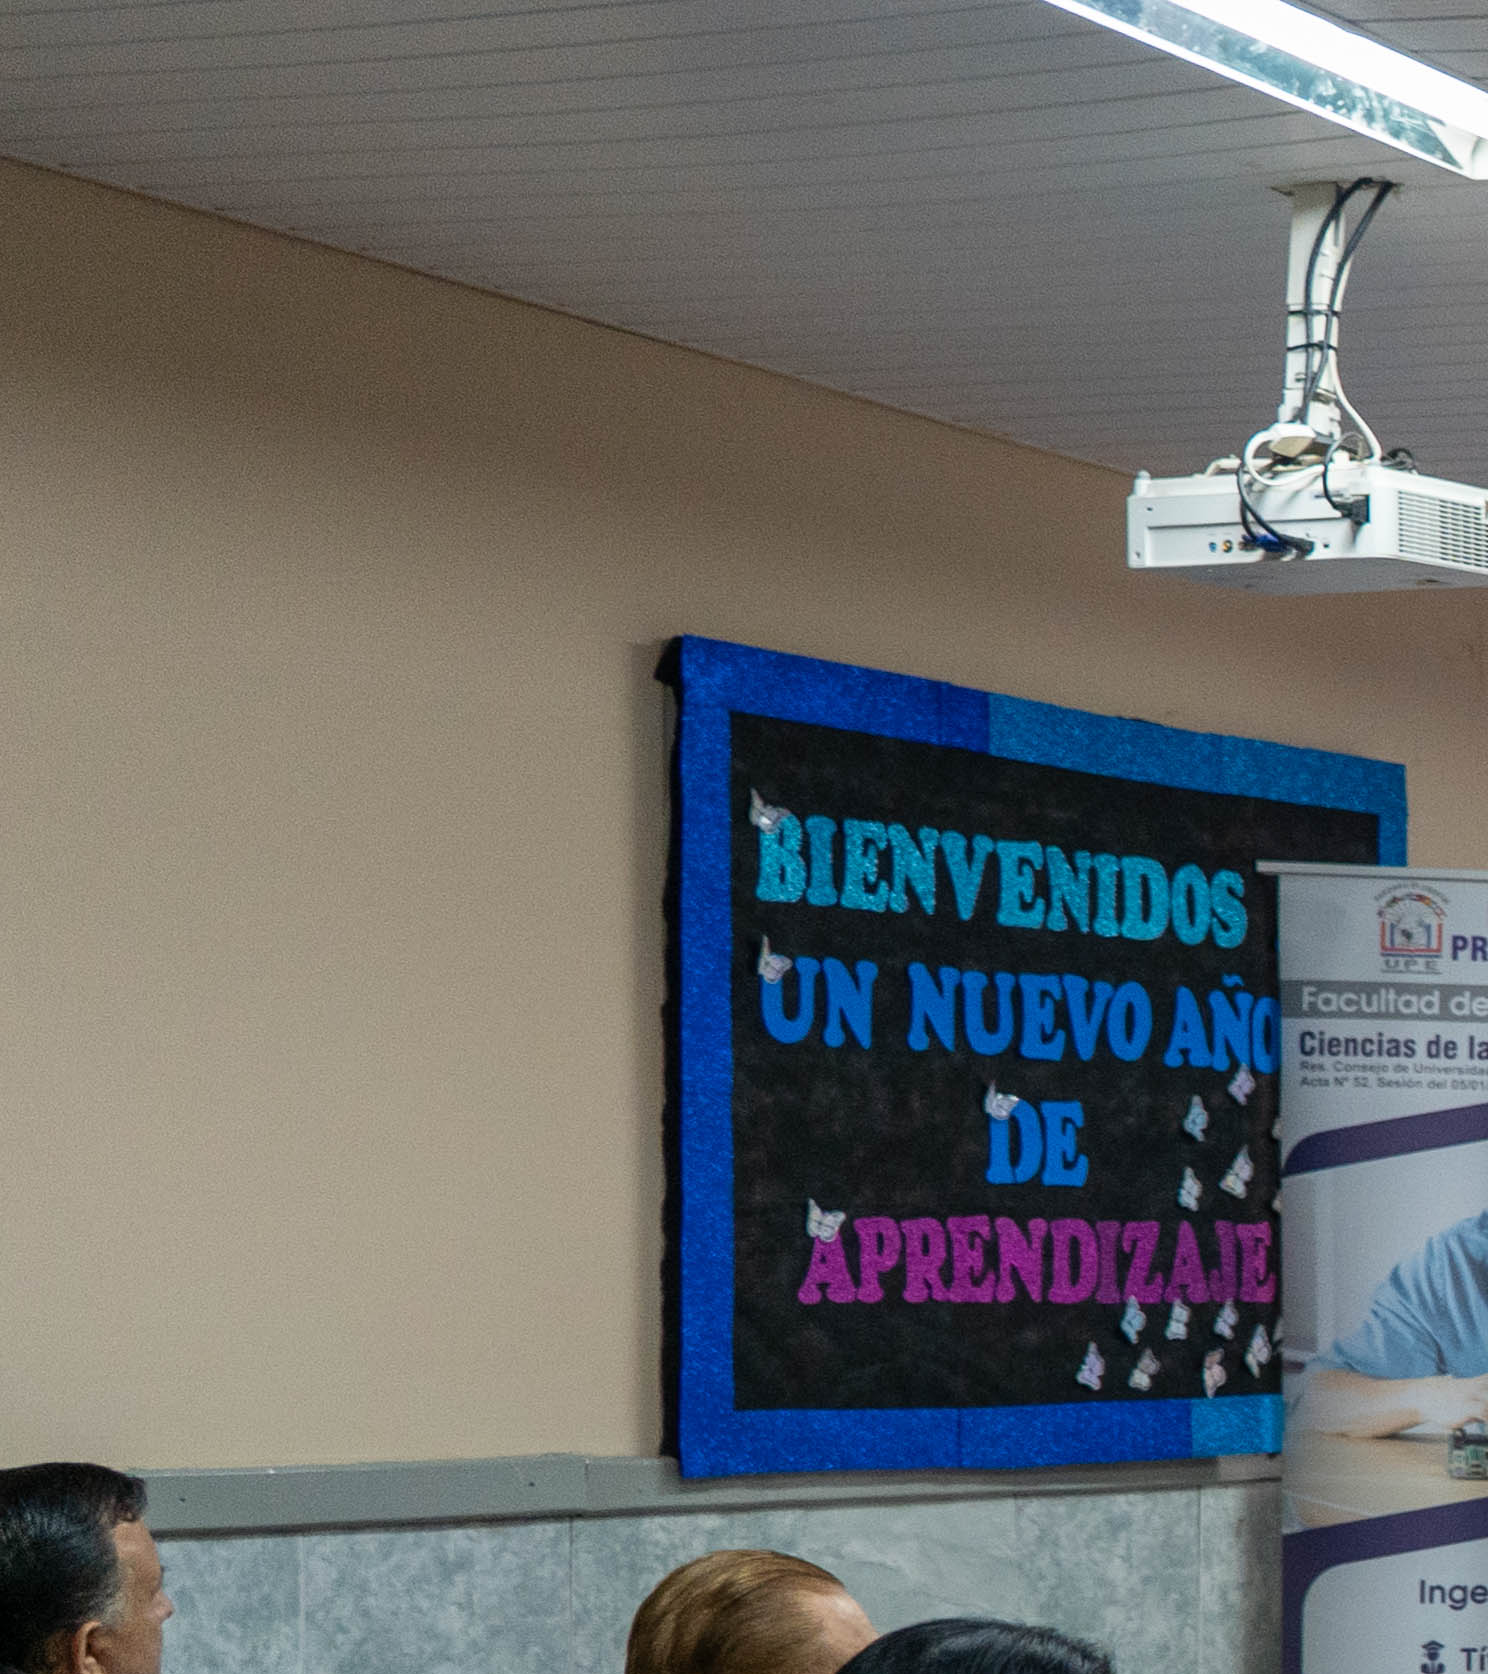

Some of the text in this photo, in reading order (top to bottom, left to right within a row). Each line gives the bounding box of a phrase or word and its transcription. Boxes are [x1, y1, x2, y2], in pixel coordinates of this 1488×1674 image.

[756, 815, 1249, 949] BIENVENIDOS
[759, 955, 879, 1051] UN
[908, 961, 1153, 1063] NUEVO
[1300, 986, 1440, 1018] Facultad
[1300, 1030, 1416, 1060] Ciencias
[1426, 1034, 1459, 1061] de
[985, 1098, 1089, 1188] DE
[798, 1214, 1277, 1305] APRENDIZAJE
